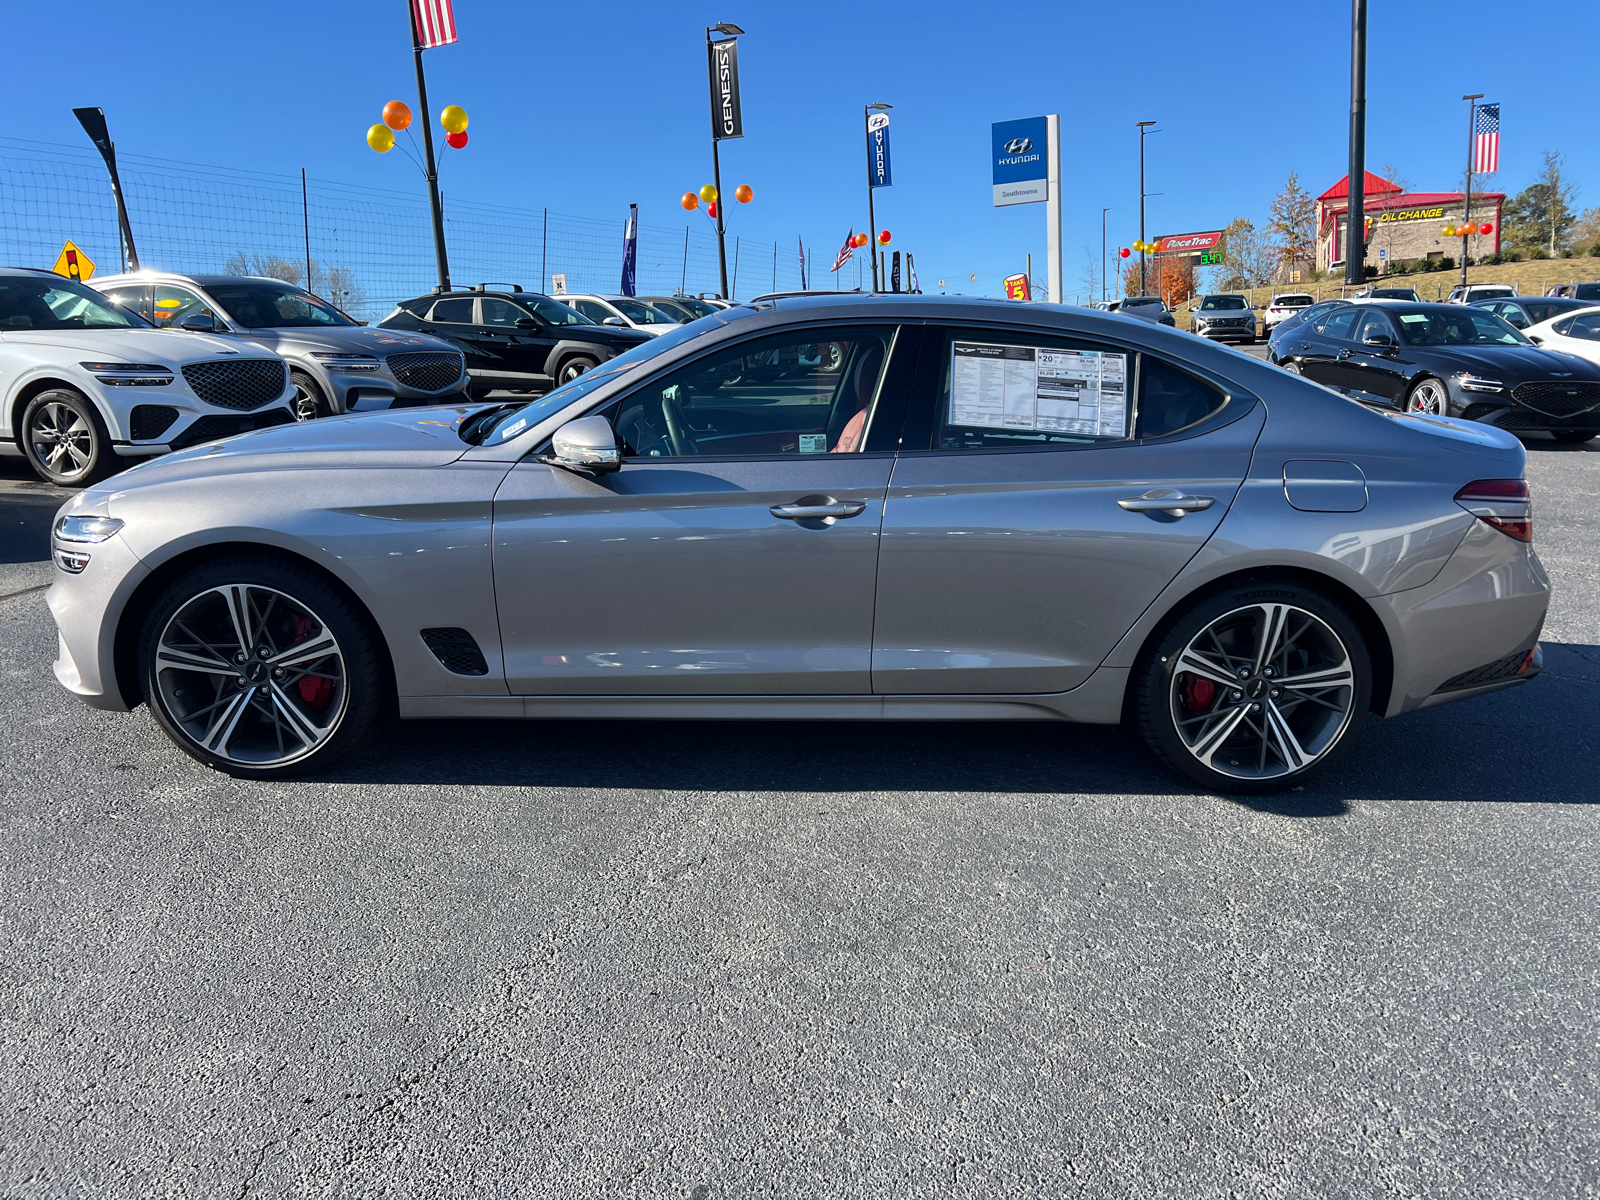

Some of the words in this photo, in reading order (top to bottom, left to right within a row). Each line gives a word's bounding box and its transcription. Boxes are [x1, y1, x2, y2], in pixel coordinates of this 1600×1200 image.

[720, 52, 734, 135] GENESIS
[875, 129, 885, 184] HYUNDAI
[998, 153, 1040, 166] HYUNDAI
[1002, 188, 1038, 198] Southtowne
[1380, 212, 1397, 222] OIL
[1398, 207, 1443, 220] CHANGE
[1009, 279, 1025, 287] TAKE
[1013, 286, 1026, 300] 5
[1042, 355, 1053, 363] 20
